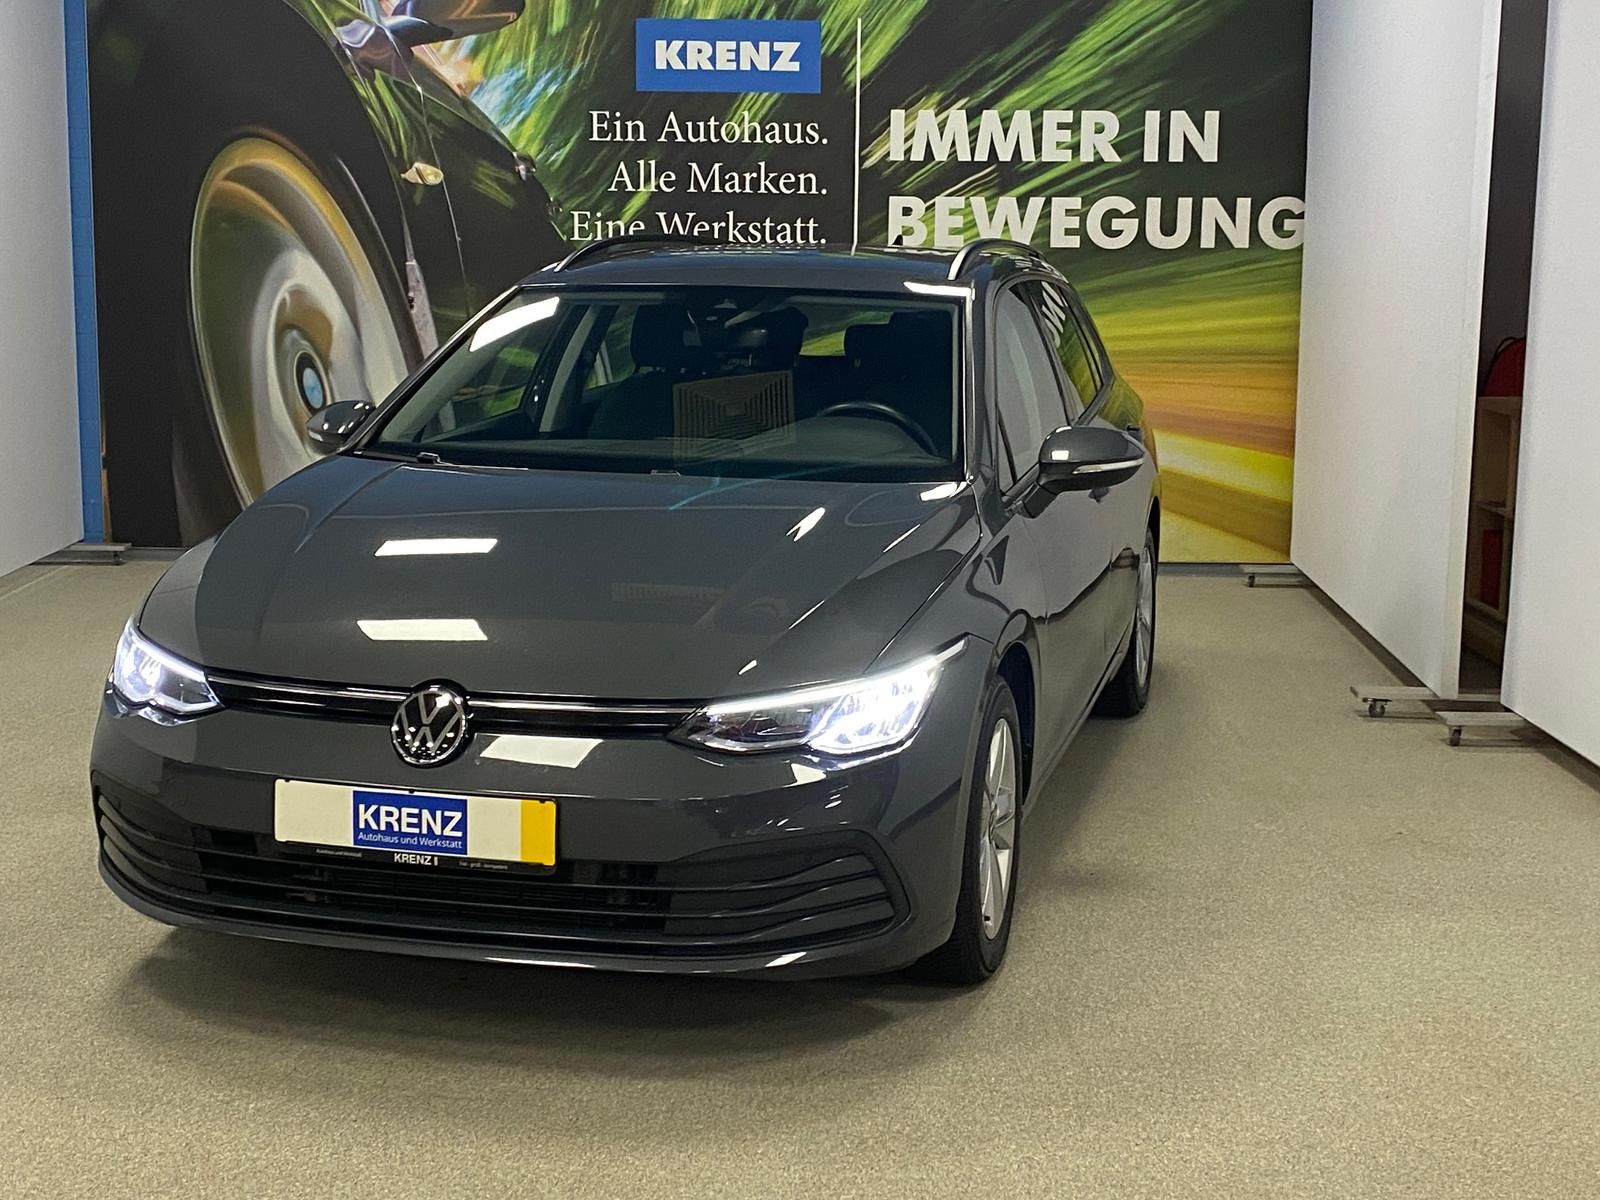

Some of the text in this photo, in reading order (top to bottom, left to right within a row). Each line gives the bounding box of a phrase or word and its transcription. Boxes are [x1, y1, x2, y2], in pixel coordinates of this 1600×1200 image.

[655, 40, 801, 72] KRENZ
[588, 110, 828, 145] Ein Autohaus.
[888, 109, 1220, 163] IMMER IN
[607, 159, 828, 195] Alle Marken.
[569, 210, 827, 245] Eine Werkstatt.
[887, 196, 1306, 250] BEWEGUNG
[358, 803, 463, 837] KRENZ
[357, 831, 463, 849] Autohaus und Werkstatt
[393, 852, 432, 866] KRENZ
